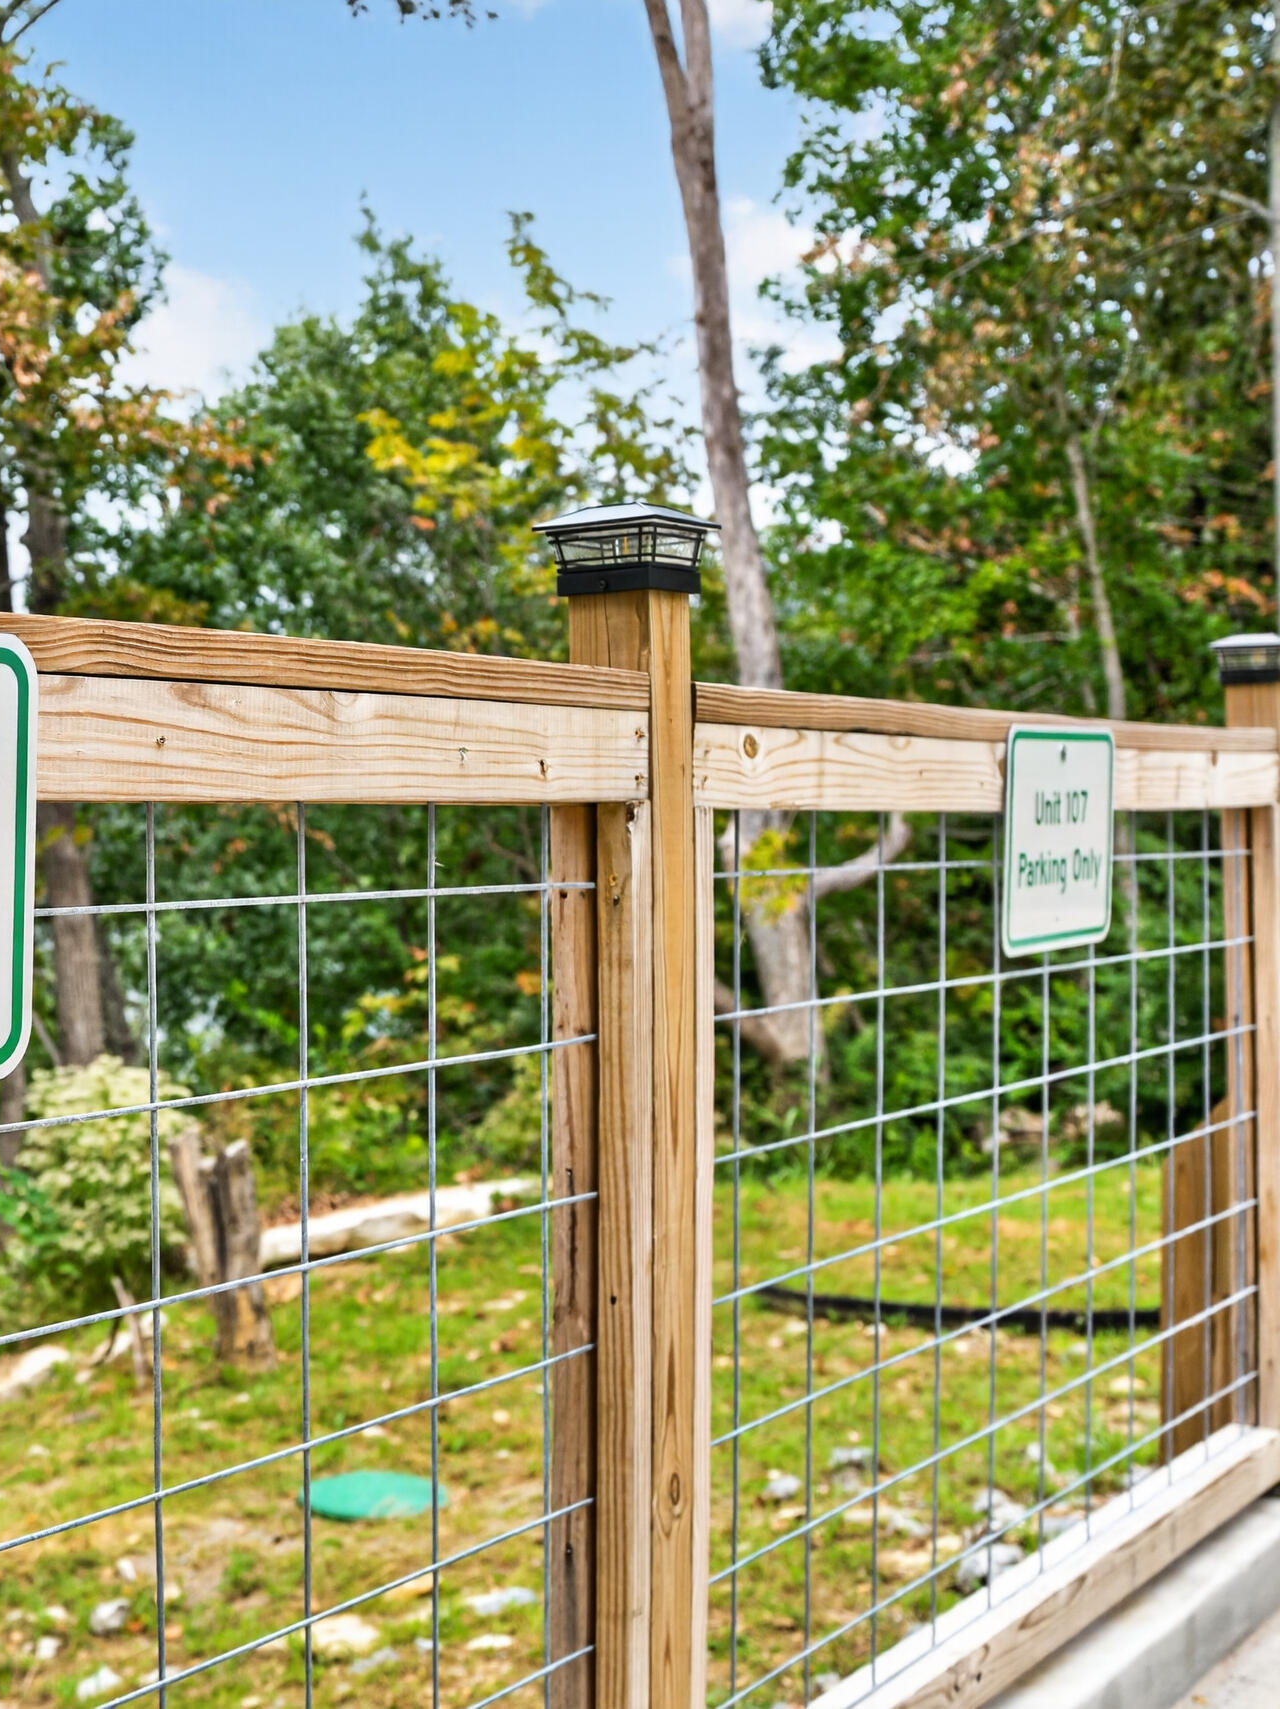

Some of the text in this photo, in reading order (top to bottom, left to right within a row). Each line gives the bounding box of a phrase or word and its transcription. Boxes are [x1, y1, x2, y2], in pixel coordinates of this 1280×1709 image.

[1035, 790, 1089, 825] Unit 107
[1017, 848, 1102, 893] Parking Only
